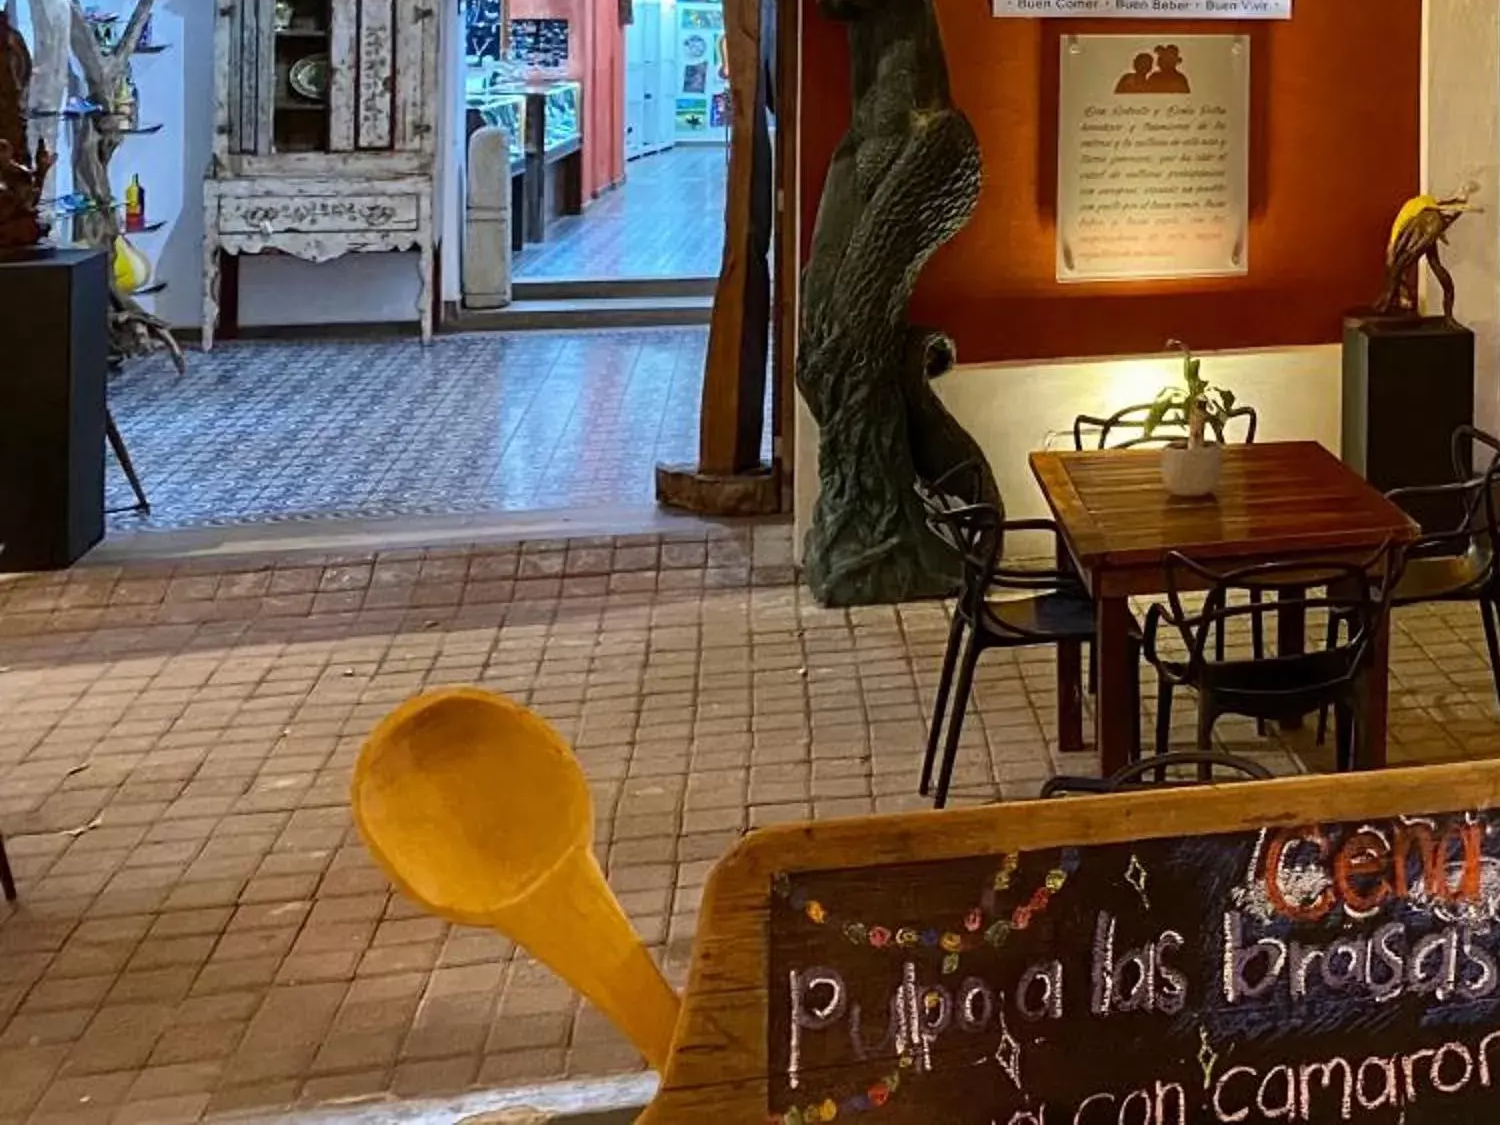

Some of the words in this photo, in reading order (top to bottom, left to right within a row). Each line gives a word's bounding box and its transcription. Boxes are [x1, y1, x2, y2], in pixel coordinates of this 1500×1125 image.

[1115, 0, 1148, 10] Buen
[1152, 0, 1190, 11] Beber
[1205, 0, 1237, 11] Buen
[1016, 960, 1063, 1019] a
[1091, 911, 1188, 1015] las
[1223, 912, 1498, 1002] brasas
